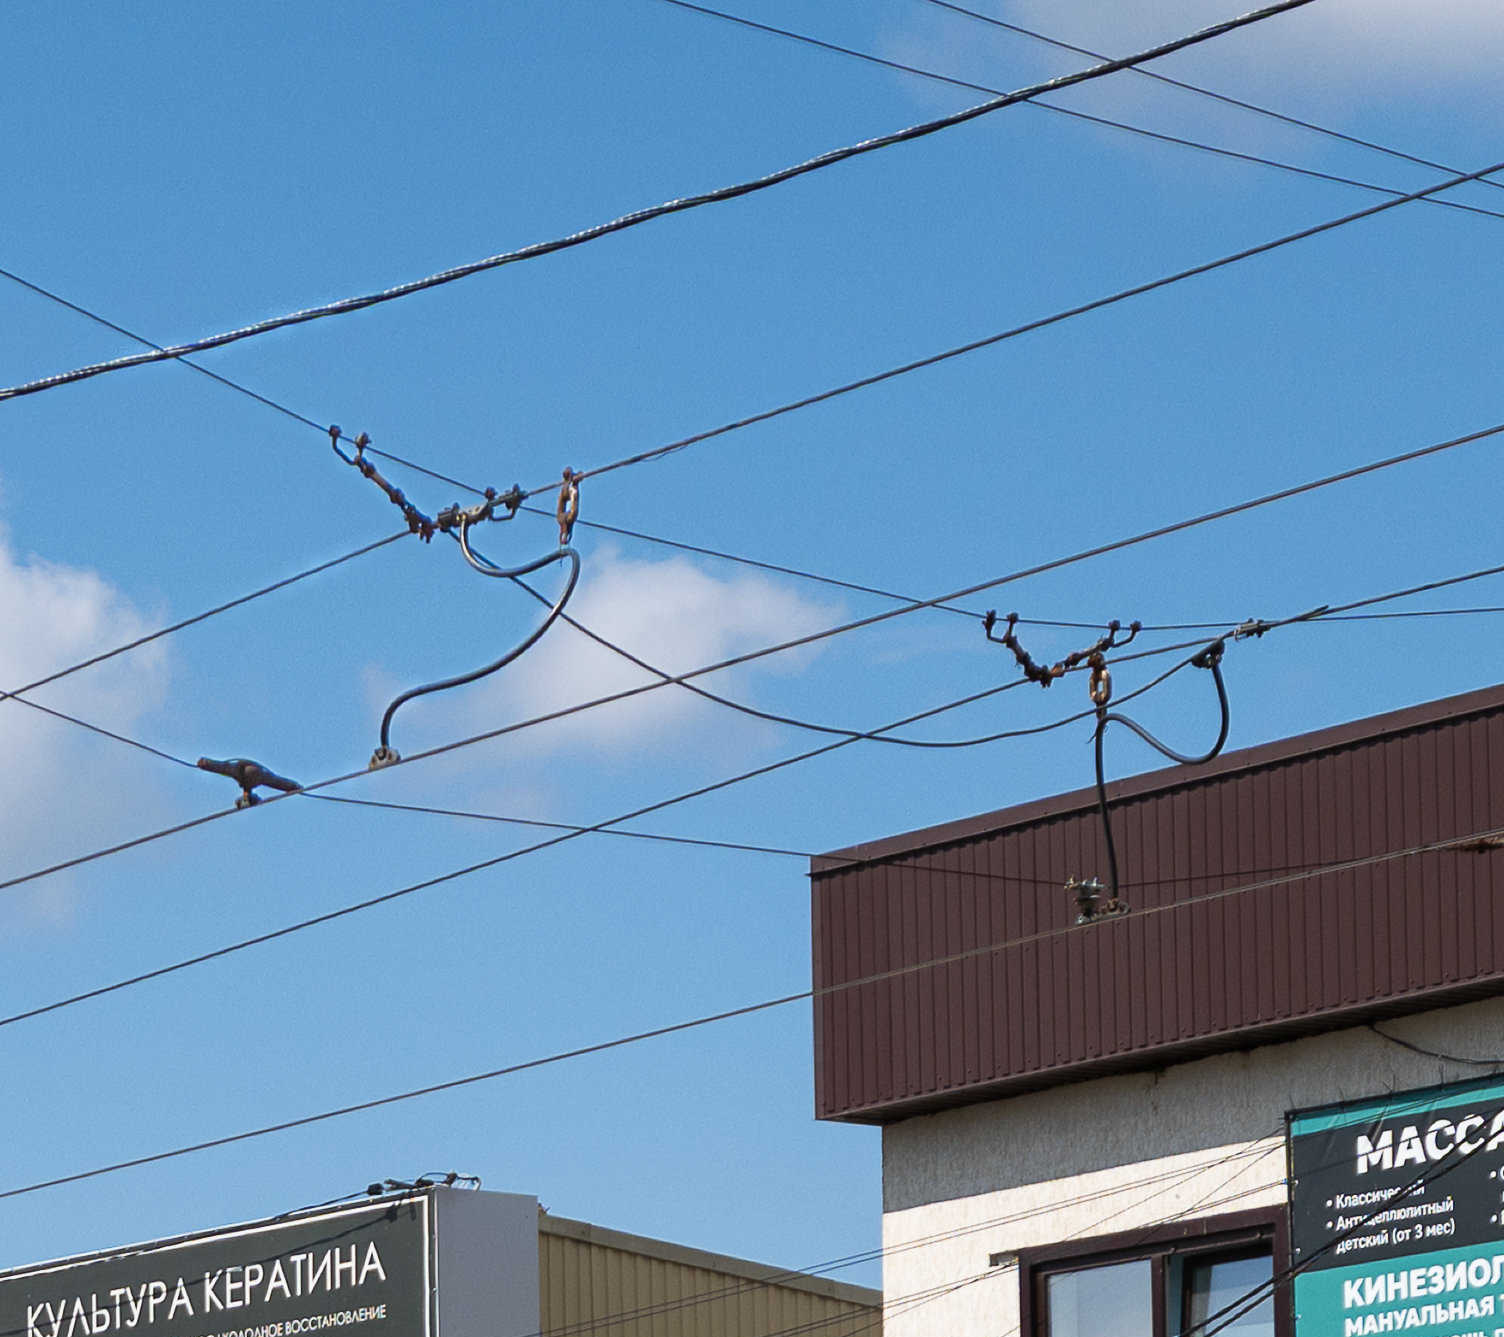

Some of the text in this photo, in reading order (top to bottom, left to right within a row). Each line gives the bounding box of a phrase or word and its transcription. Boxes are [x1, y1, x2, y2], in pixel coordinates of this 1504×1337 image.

[204, 1240, 386, 1313] КЕРАТИНА
[286, 1304, 386, 1336] ВОССТАНОВЛЕНИЕ
[1345, 1296, 1494, 1337] МАНУАЛЬНАЯ
